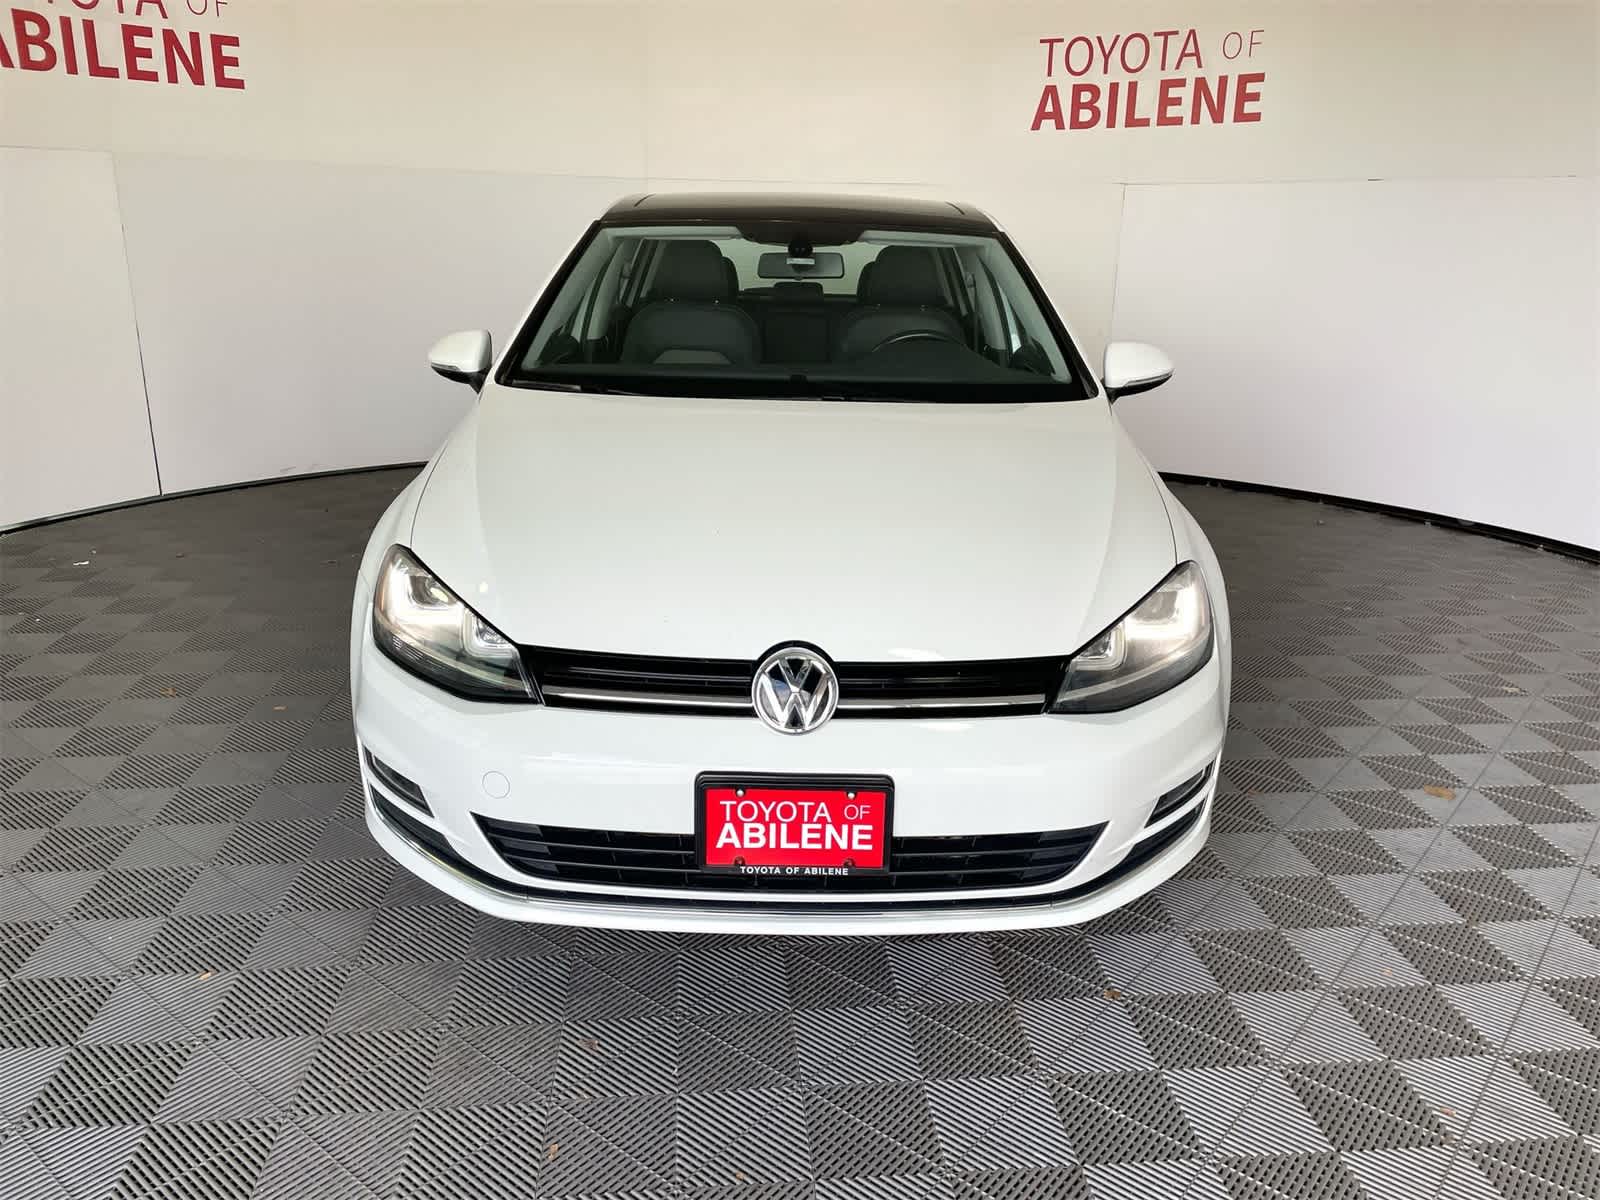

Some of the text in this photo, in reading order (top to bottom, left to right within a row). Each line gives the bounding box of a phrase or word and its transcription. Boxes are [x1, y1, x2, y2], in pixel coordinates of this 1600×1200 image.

[1039, 29, 1265, 77] TOYOTA OF
[1030, 72, 1266, 131] ABILENE
[719, 800, 871, 822] TOYOTA OF
[715, 822, 873, 850] ABILENE
[740, 866, 781, 874] TOYOTA
[804, 867, 849, 876] ABILENE
